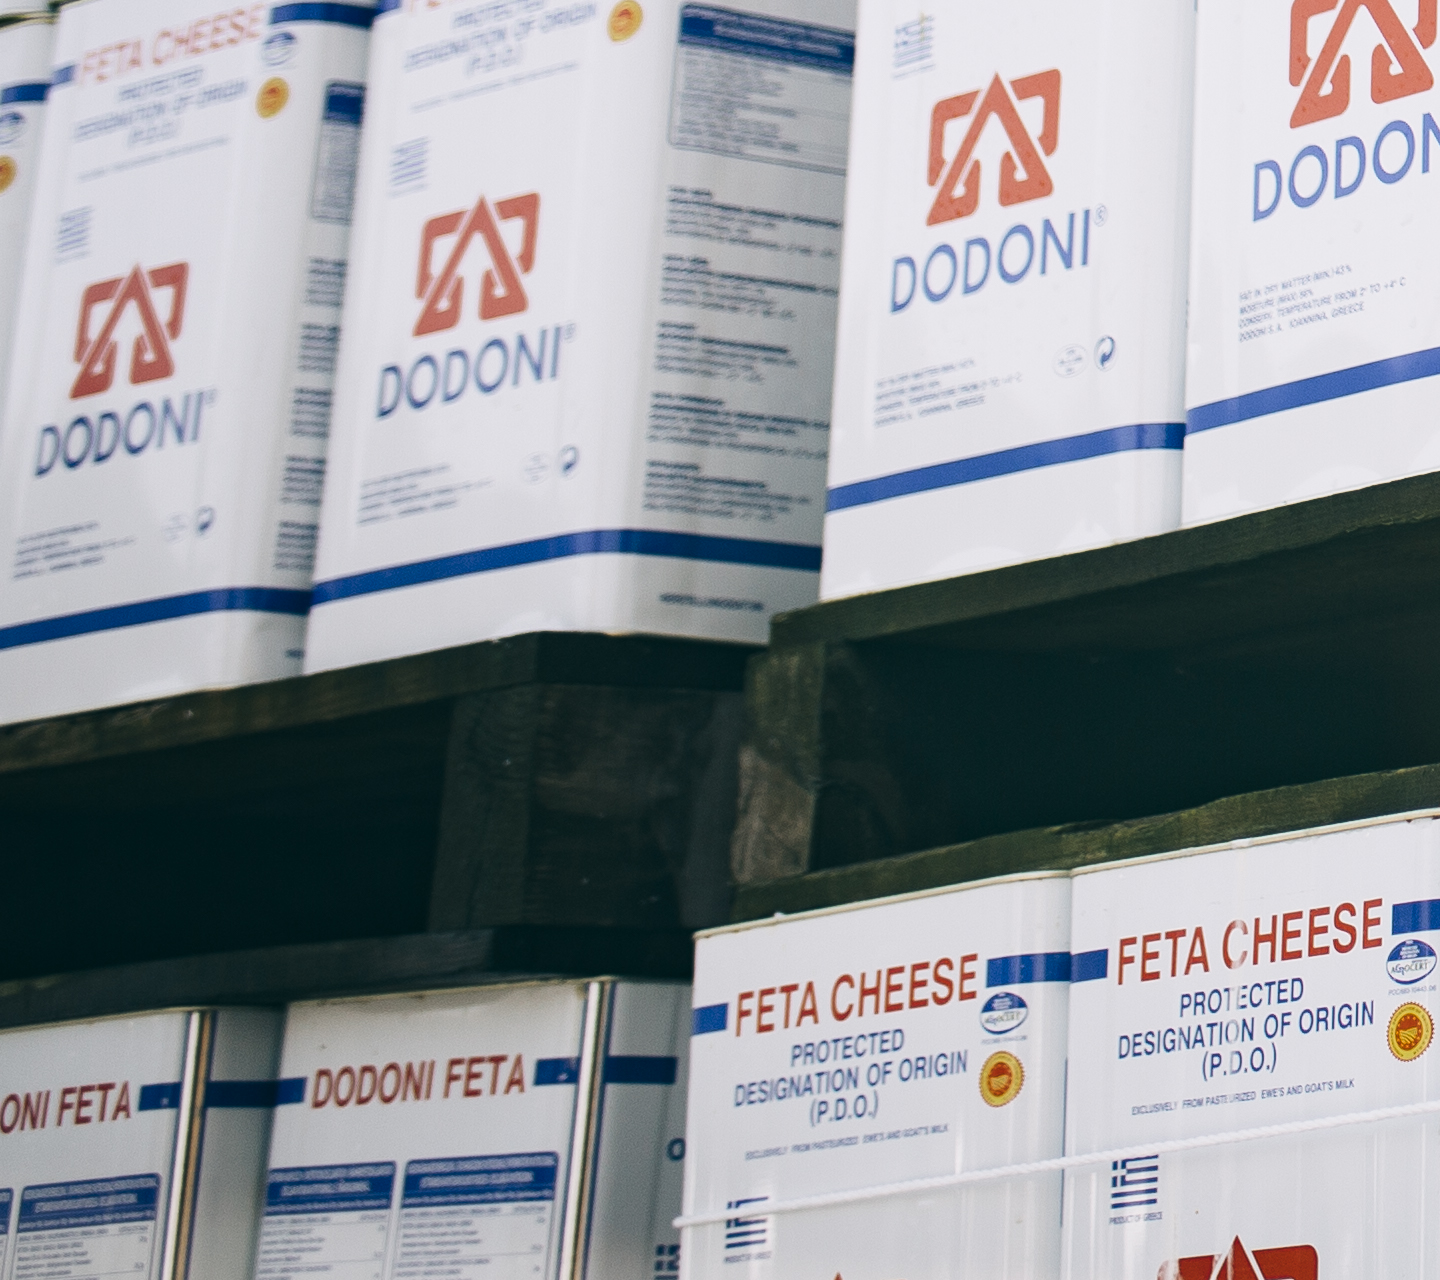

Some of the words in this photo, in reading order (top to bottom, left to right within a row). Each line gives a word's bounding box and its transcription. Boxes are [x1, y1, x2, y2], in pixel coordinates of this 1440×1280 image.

[82, 41, 142, 83] FETA
[152, 4, 262, 67] CHEESE
[1118, 926, 1209, 985] FETA
[1223, 898, 1382, 969] CHEESE
[737, 980, 819, 1036] FETA
[831, 953, 978, 1022] CHEESE
[1180, 977, 1303, 1018] PROTECTED
[792, 1028, 904, 1066] PROTECTED
[1119, 1017, 1254, 1060] DESIGNATION
[1264, 1012, 1291, 1040] OF
[1299, 1000, 1373, 1035] ORIGIN
[311, 1059, 436, 1110] DODONI
[443, 1053, 526, 1099] FETA
[735, 1067, 858, 1108] DESIGNATION
[867, 1061, 892, 1087] OF
[899, 1051, 966, 1083] ORIGIN
[1202, 1042, 1276, 1082] (P.D.O.)
[56, 1080, 131, 1127] FETA
[810, 1091, 878, 1126] (P.D.O.)
